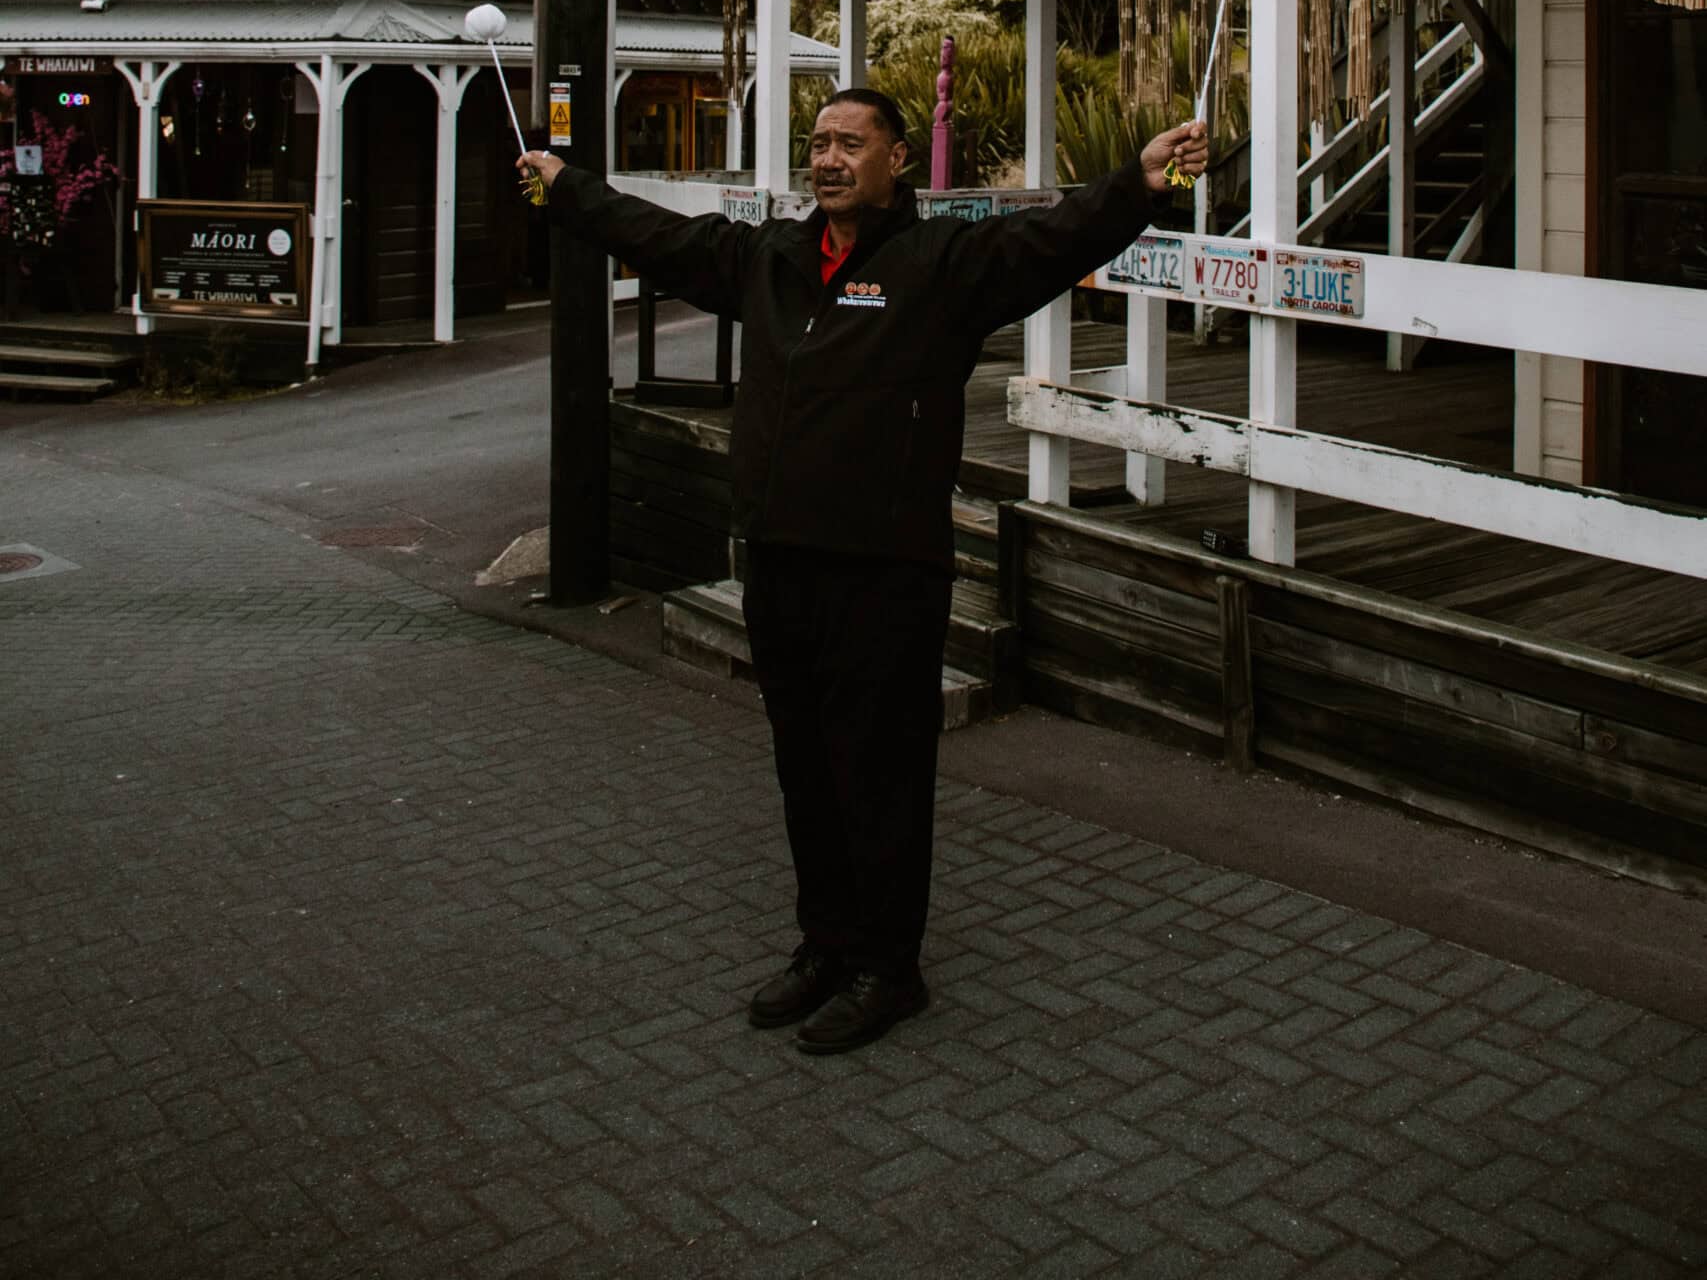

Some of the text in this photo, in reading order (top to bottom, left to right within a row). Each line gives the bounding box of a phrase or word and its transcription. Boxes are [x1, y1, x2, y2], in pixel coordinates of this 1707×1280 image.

[18, 57, 96, 72] TE WHATAIWI
[58, 92, 90, 108] open
[1194, 256, 1258, 290] W 7780
[1212, 288, 1241, 297] TRAILER
[1280, 297, 1354, 313] NORTH CAROLINA
